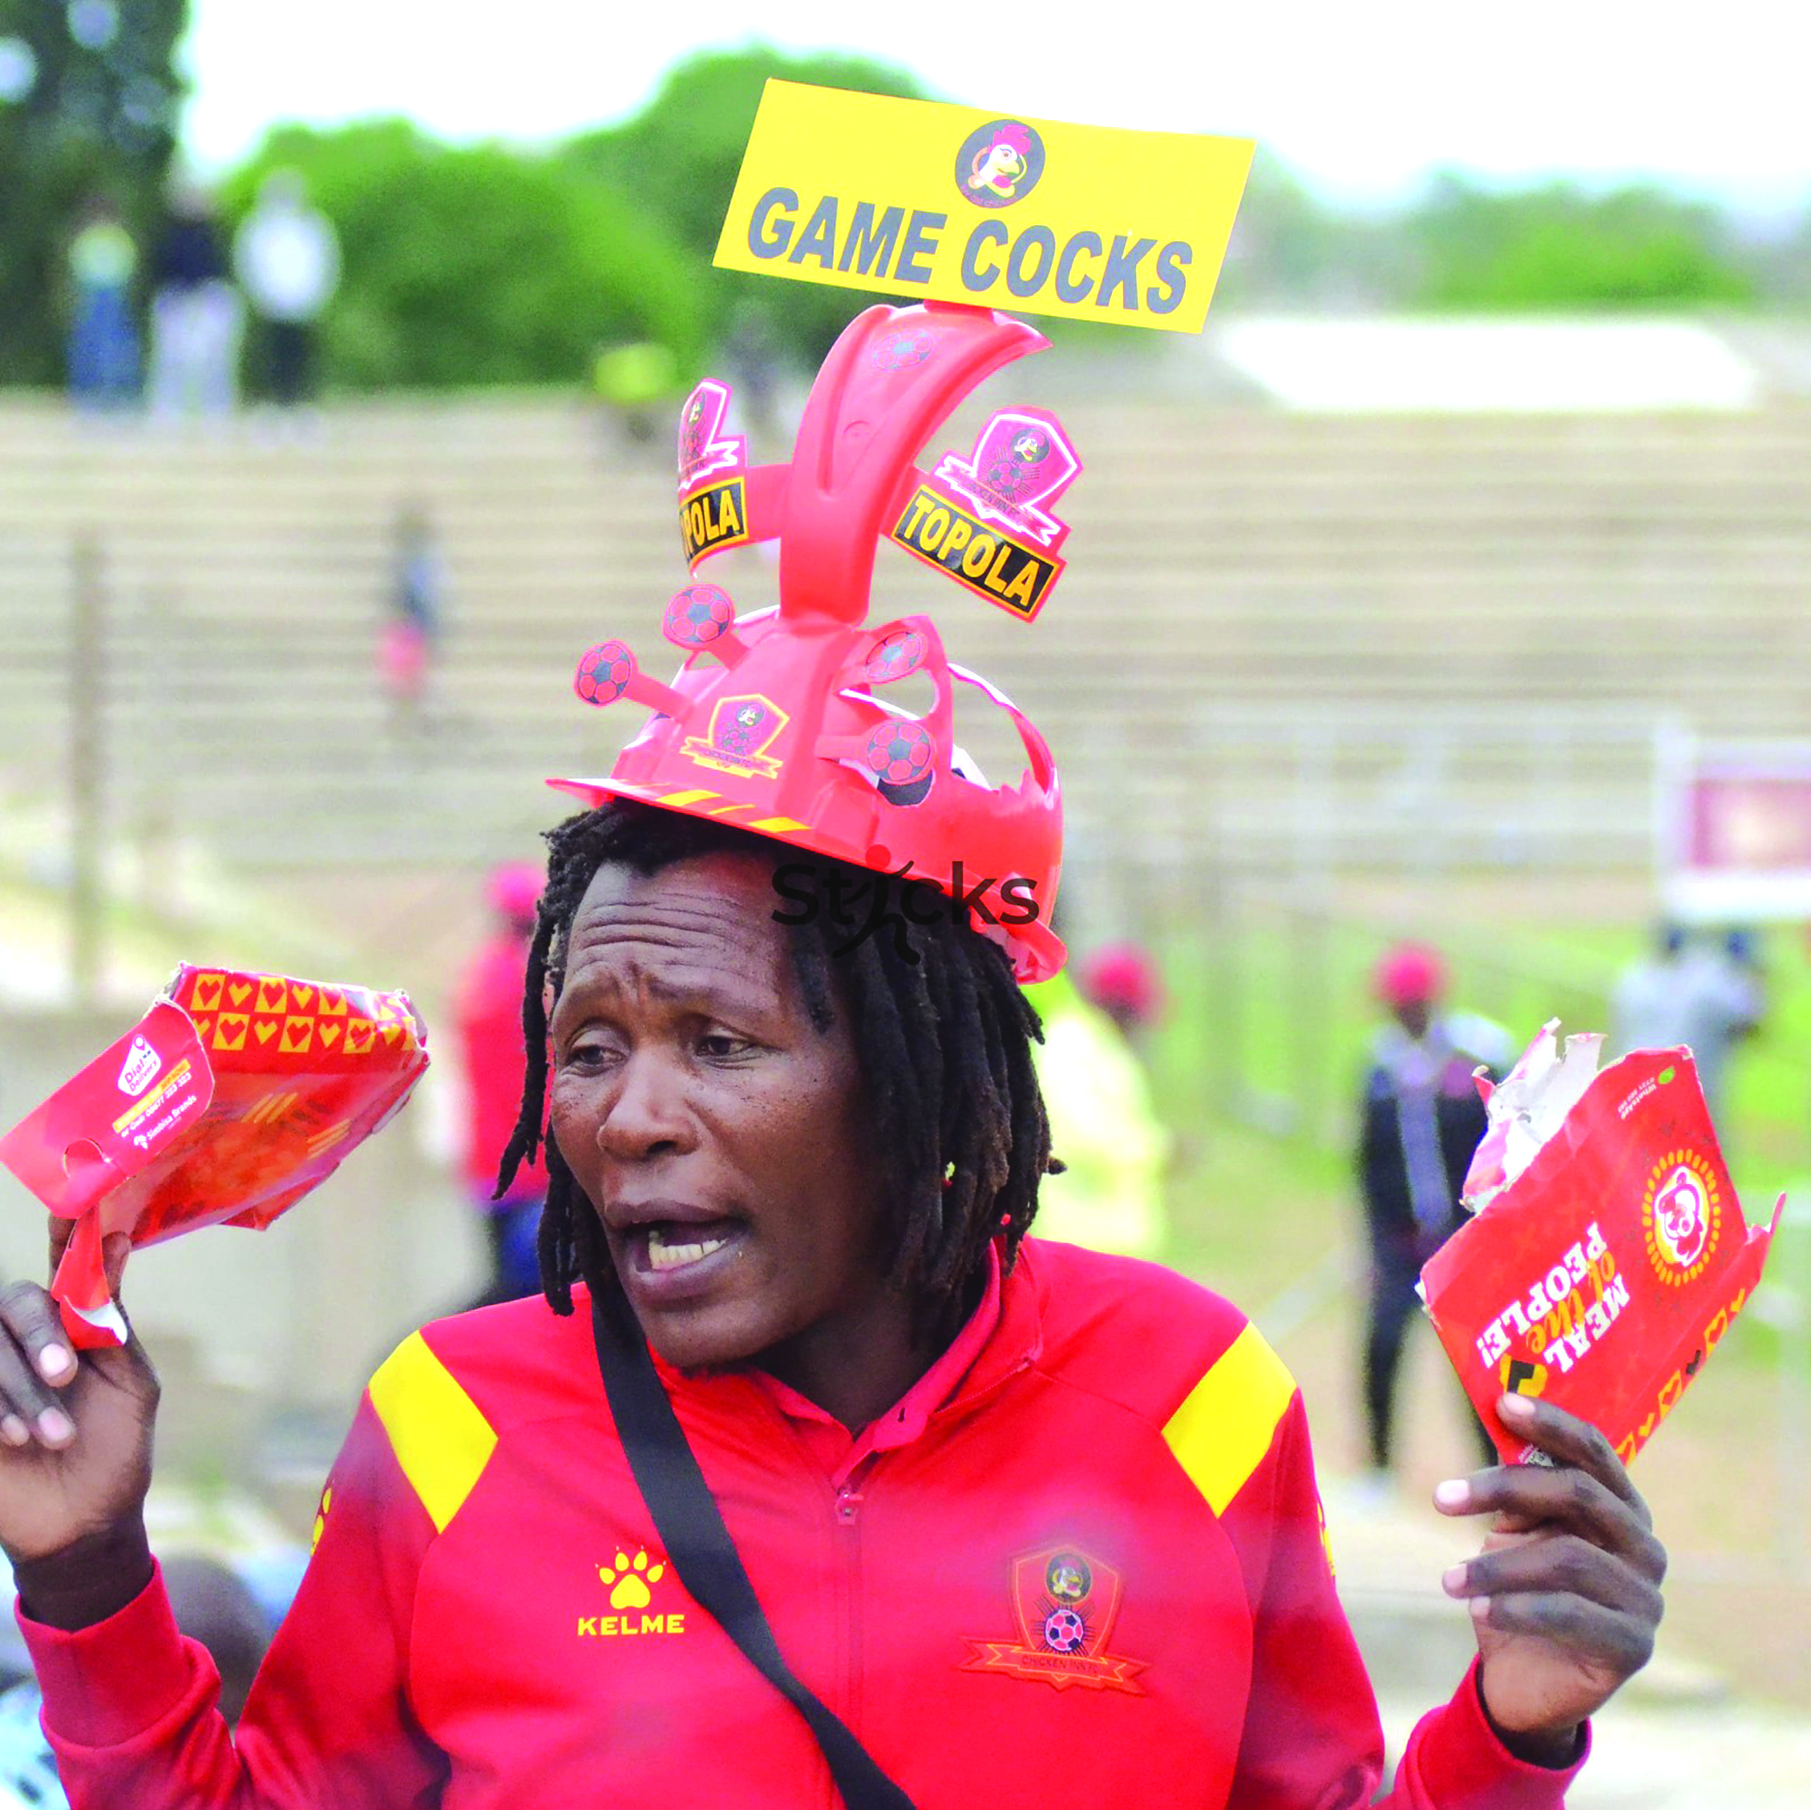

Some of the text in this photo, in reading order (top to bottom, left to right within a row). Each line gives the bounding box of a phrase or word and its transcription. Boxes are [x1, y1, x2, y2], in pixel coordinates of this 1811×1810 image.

[747, 187, 1193, 315] GAME COCKS
[903, 495, 1042, 607] TOPOLA
[125, 1058, 145, 1084] Dial
[130, 1059, 157, 1092] Delivery
[1621, 1083, 1657, 1119] WhatsApp
[146, 1115, 173, 1140] Simbisa
[172, 1095, 197, 1118] Brands
[1476, 1221, 1607, 1369] PEOPLE!
[1526, 1251, 1615, 1354] of the
[1543, 1273, 1630, 1373] MEAL
[577, 1614, 685, 1636] KELME
